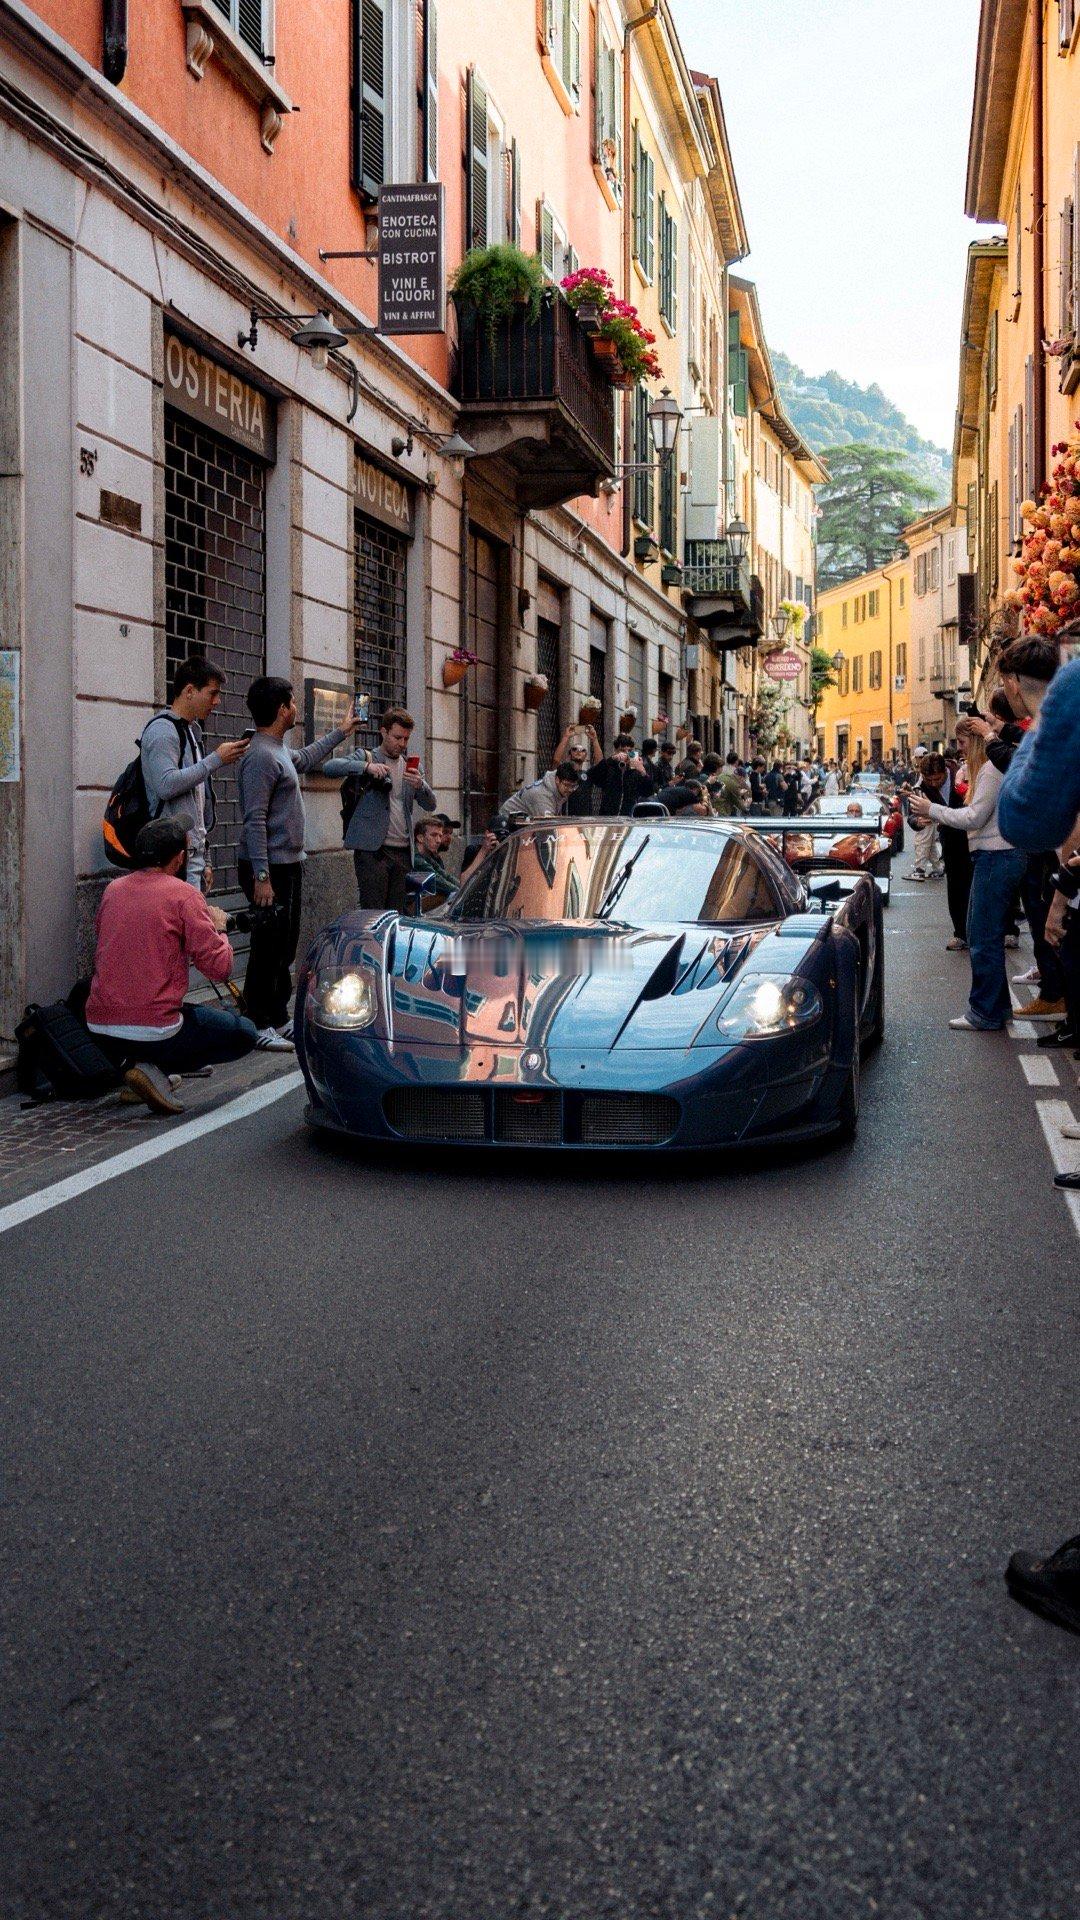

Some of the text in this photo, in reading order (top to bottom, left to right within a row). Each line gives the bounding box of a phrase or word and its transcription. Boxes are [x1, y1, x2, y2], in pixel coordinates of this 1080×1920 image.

[382, 194, 437, 203] CANTINAFRASCA
[382, 215, 437, 227] ENOTECA
[382, 228, 437, 238] CON CUCINA
[382, 252, 436, 265] BISTROT
[392, 277, 428, 289] VINI E
[384, 290, 435, 302] LIQUORI
[384, 311, 435, 320] VINI & AFFINI
[166, 335, 265, 439] OSTERIA
[353, 455, 410, 522] NOTECA
